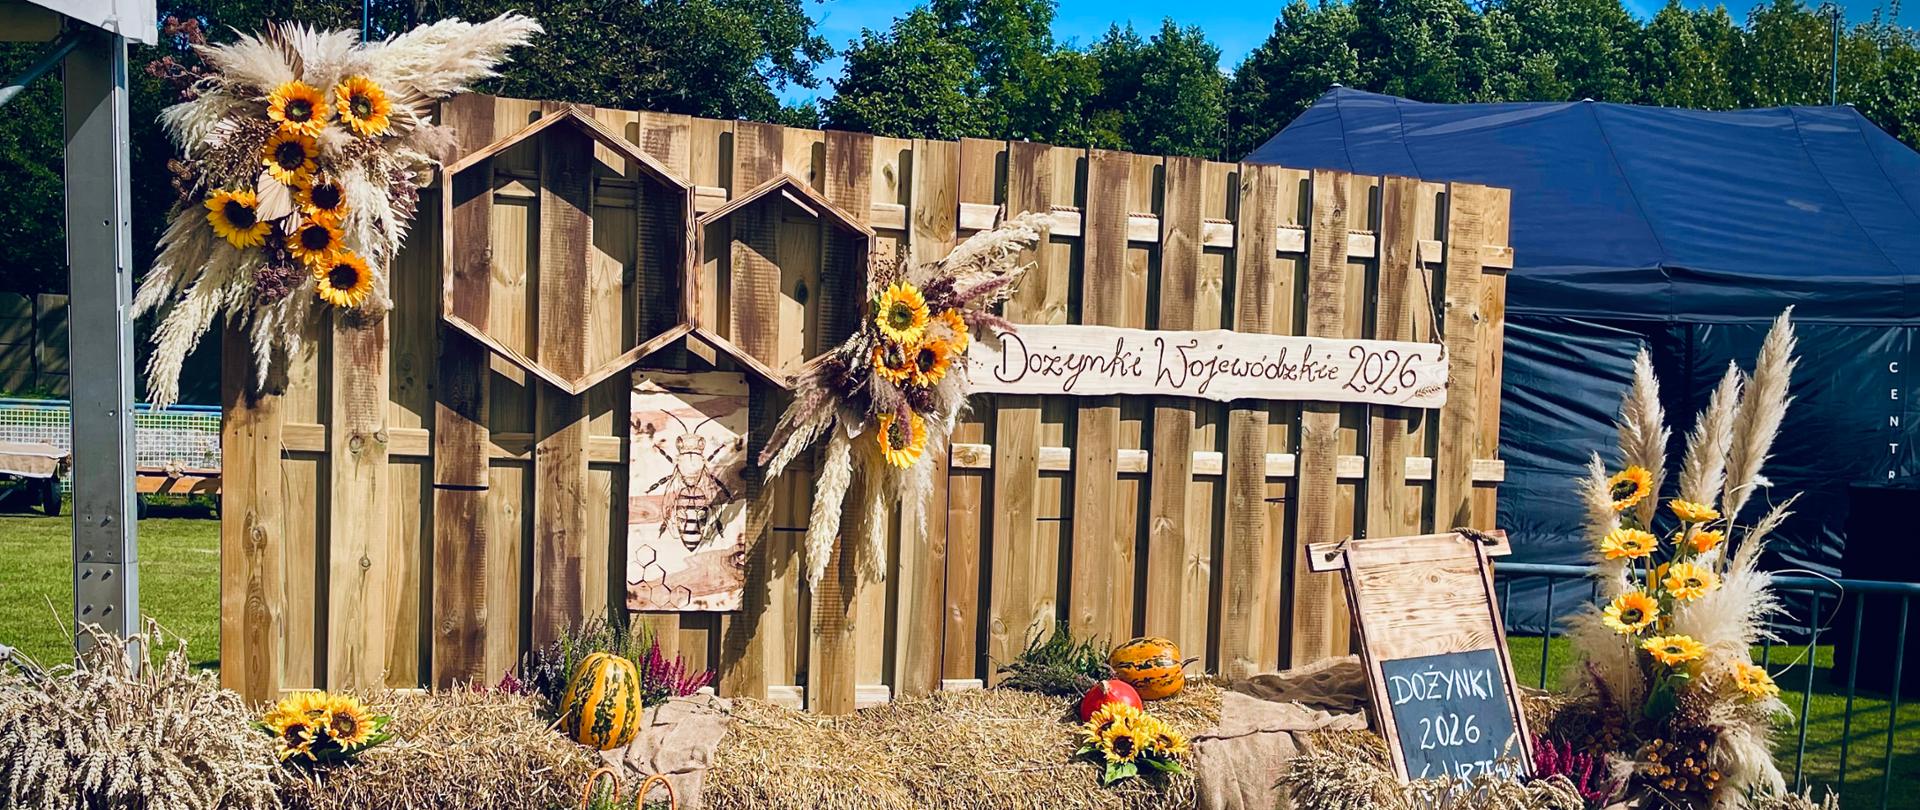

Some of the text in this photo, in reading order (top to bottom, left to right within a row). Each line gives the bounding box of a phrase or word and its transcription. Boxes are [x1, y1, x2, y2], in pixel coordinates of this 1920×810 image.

[994, 331, 1422, 395] Dożynki Wojewódzkie 2026
[1390, 664, 1494, 705] DOŻYNKI
[1419, 713, 1481, 750] 2026
